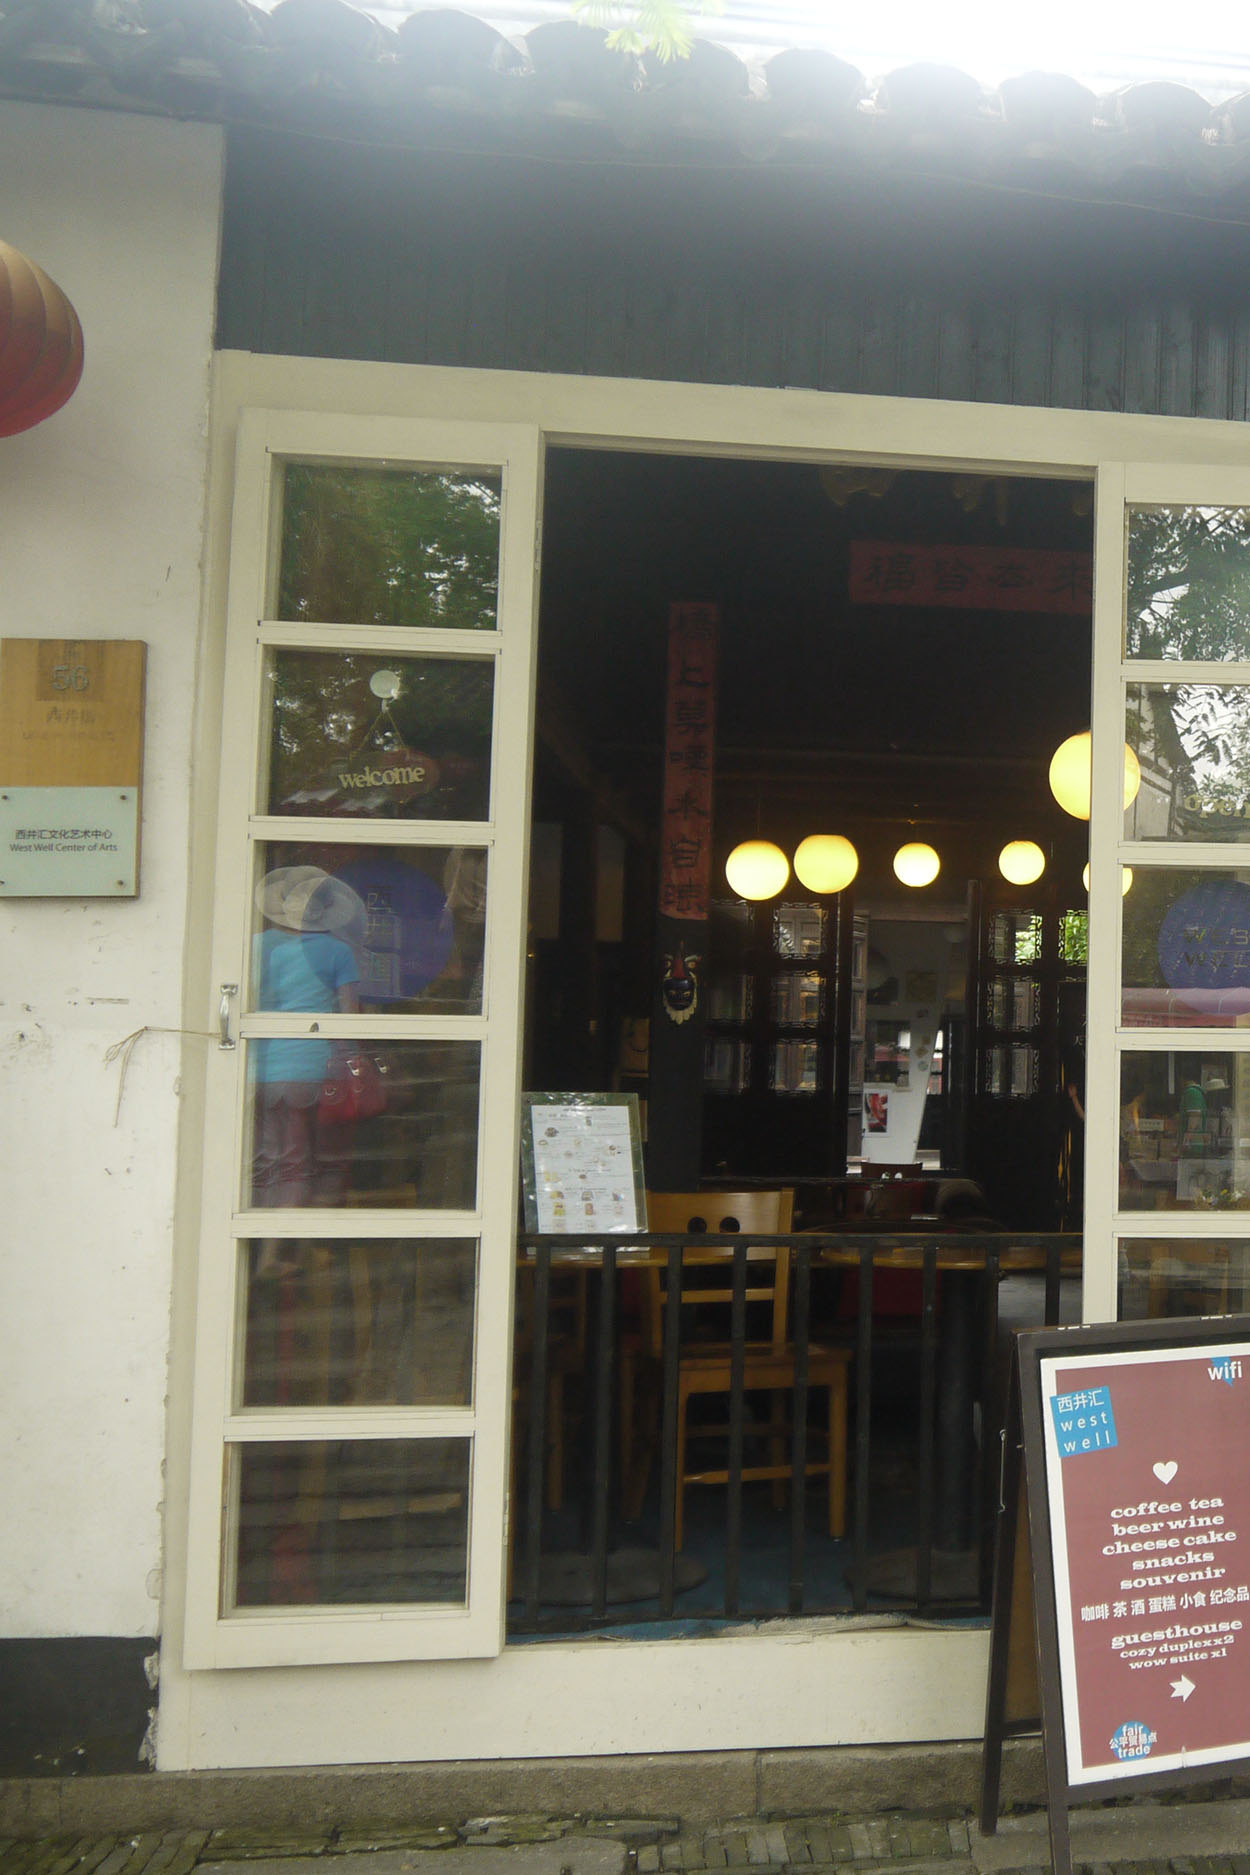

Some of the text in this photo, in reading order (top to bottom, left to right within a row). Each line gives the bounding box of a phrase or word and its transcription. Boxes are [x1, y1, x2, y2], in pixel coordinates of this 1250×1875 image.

[338, 766, 425, 789] welcome
[15, 829, 113, 840] 西井汇文化艺术中心
[9, 842, 118, 852] West Well Center of Arts
[1207, 1360, 1243, 1381] wifi
[1057, 1390, 1105, 1414] 西井汇
[1060, 1412, 1108, 1432] west
[1064, 1433, 1111, 1453] well
[1110, 1497, 1225, 1519] coffee tea
[1111, 1515, 1225, 1537] beer wine
[1102, 1530, 1238, 1556] cheese cake
[1131, 1550, 1215, 1571] snacks
[1119, 1566, 1227, 1591] souvenir
[1081, 1603, 1110, 1622] 咖啡
[1112, 1601, 1127, 1618] 茶
[1131, 1599, 1145, 1616] 酒
[1147, 1595, 1177, 1614] 蛋糕
[1179, 1591, 1206, 1610] 小食
[1209, 1585, 1250, 1606] 纪念品
[1111, 1619, 1243, 1649] guesthouse
[1119, 1646, 1157, 1659] cozy
[1128, 1657, 1168, 1670] wow
[1169, 1650, 1209, 1664] suite
[1121, 1723, 1144, 1737] fair
[1117, 1744, 1151, 1759] trade
